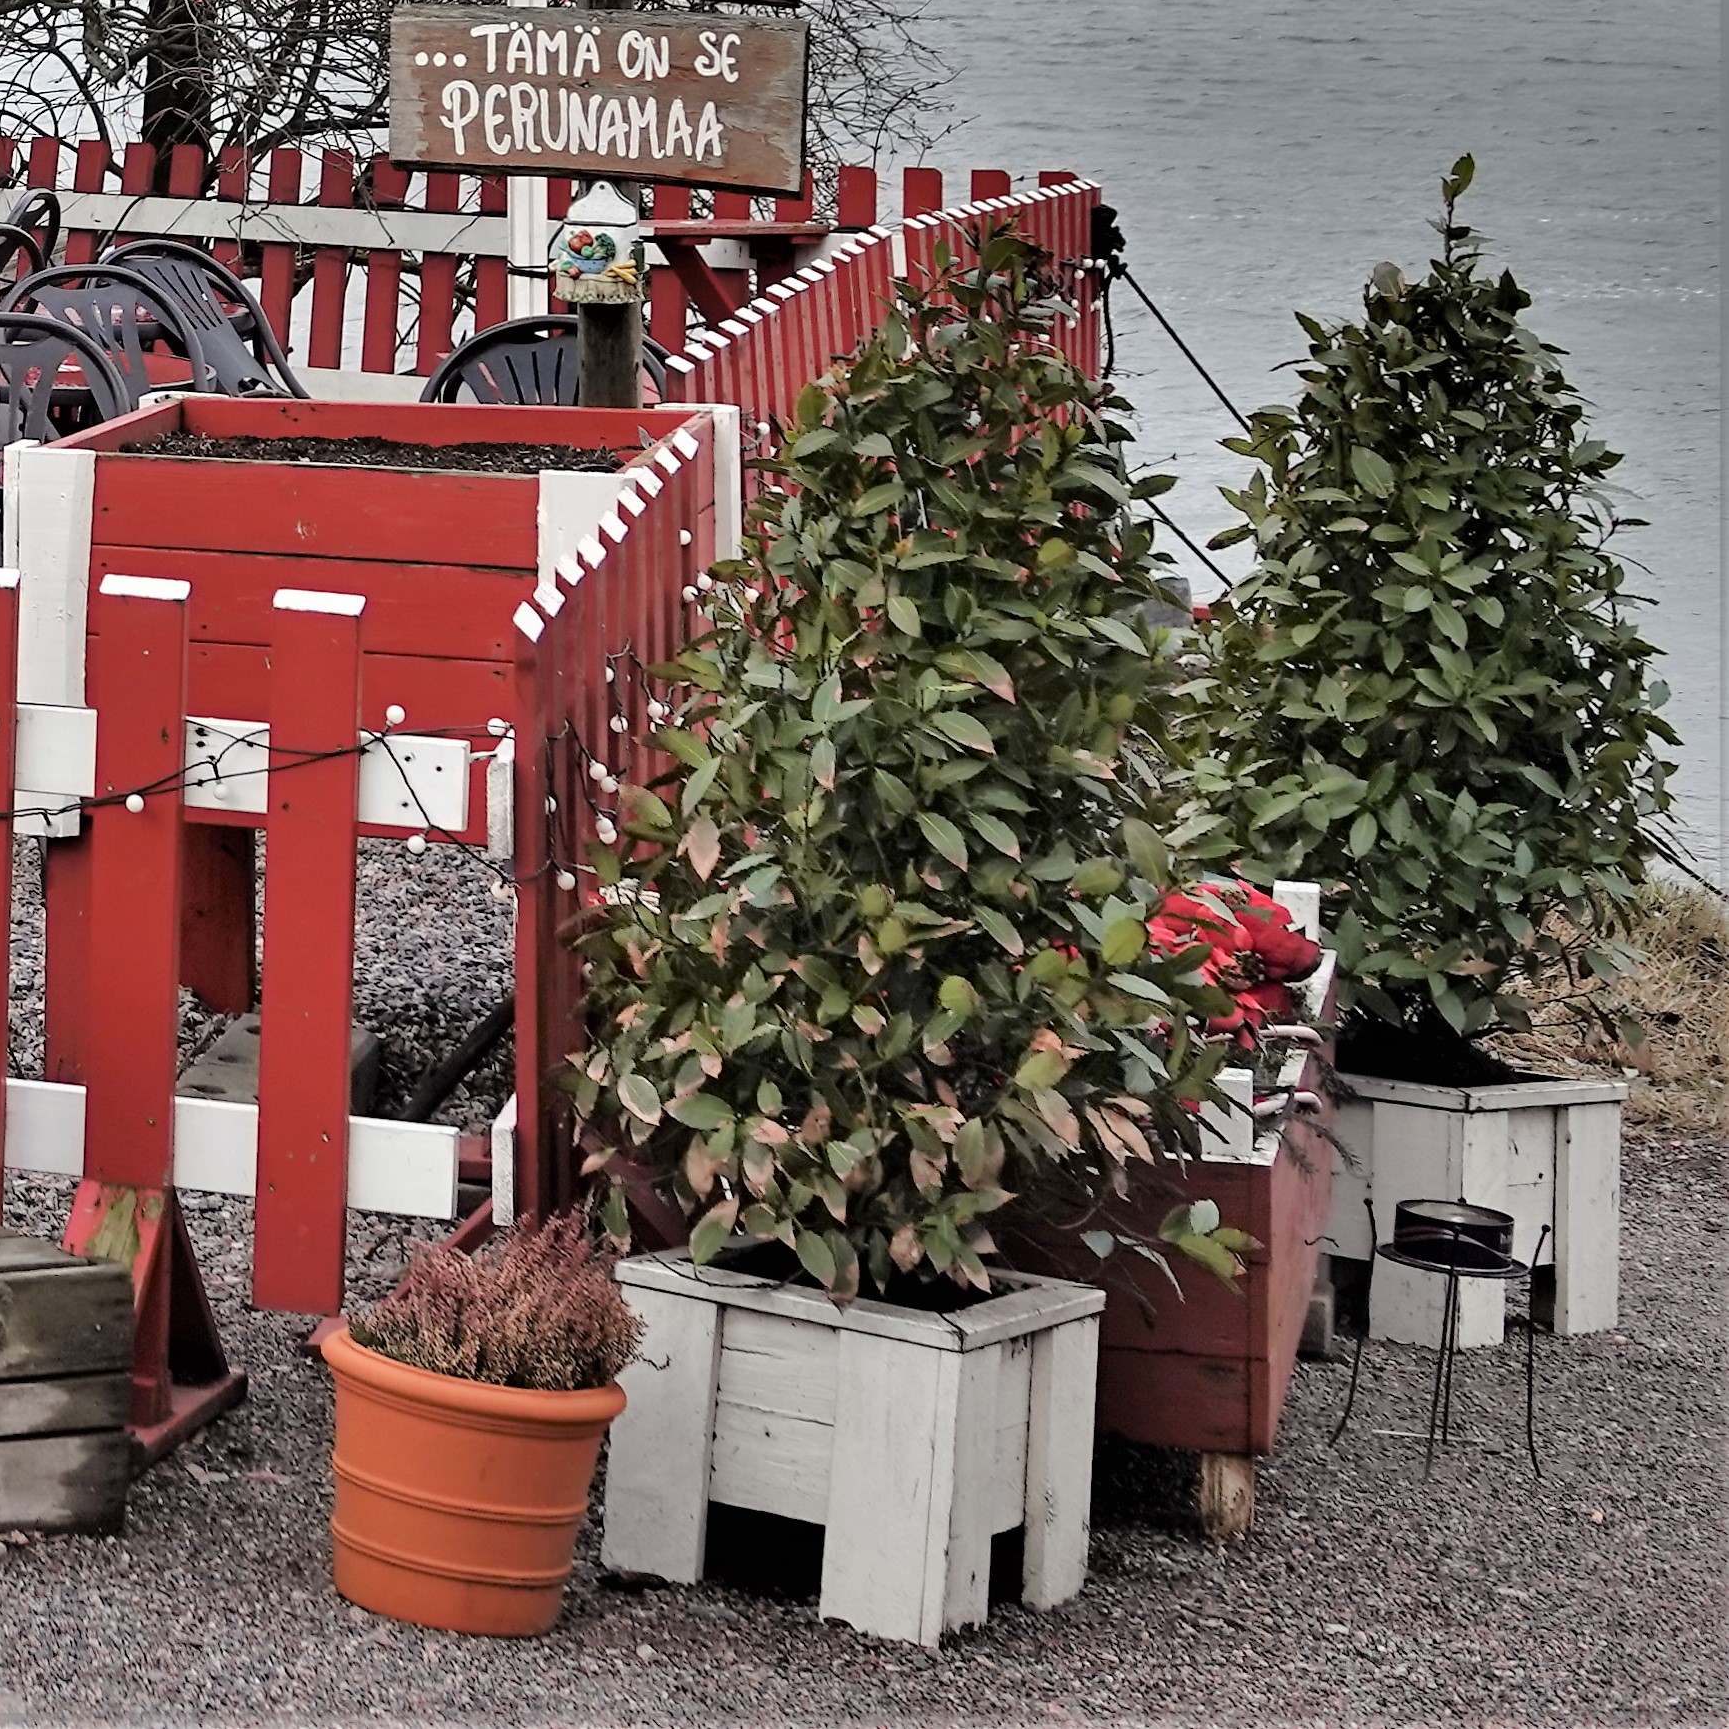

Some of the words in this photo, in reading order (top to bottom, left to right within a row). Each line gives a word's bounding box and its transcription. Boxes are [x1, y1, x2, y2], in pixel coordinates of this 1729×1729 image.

[617, 28, 671, 82] ON
[693, 30, 743, 83] SE
[439, 79, 724, 161] PERUNAMAA
